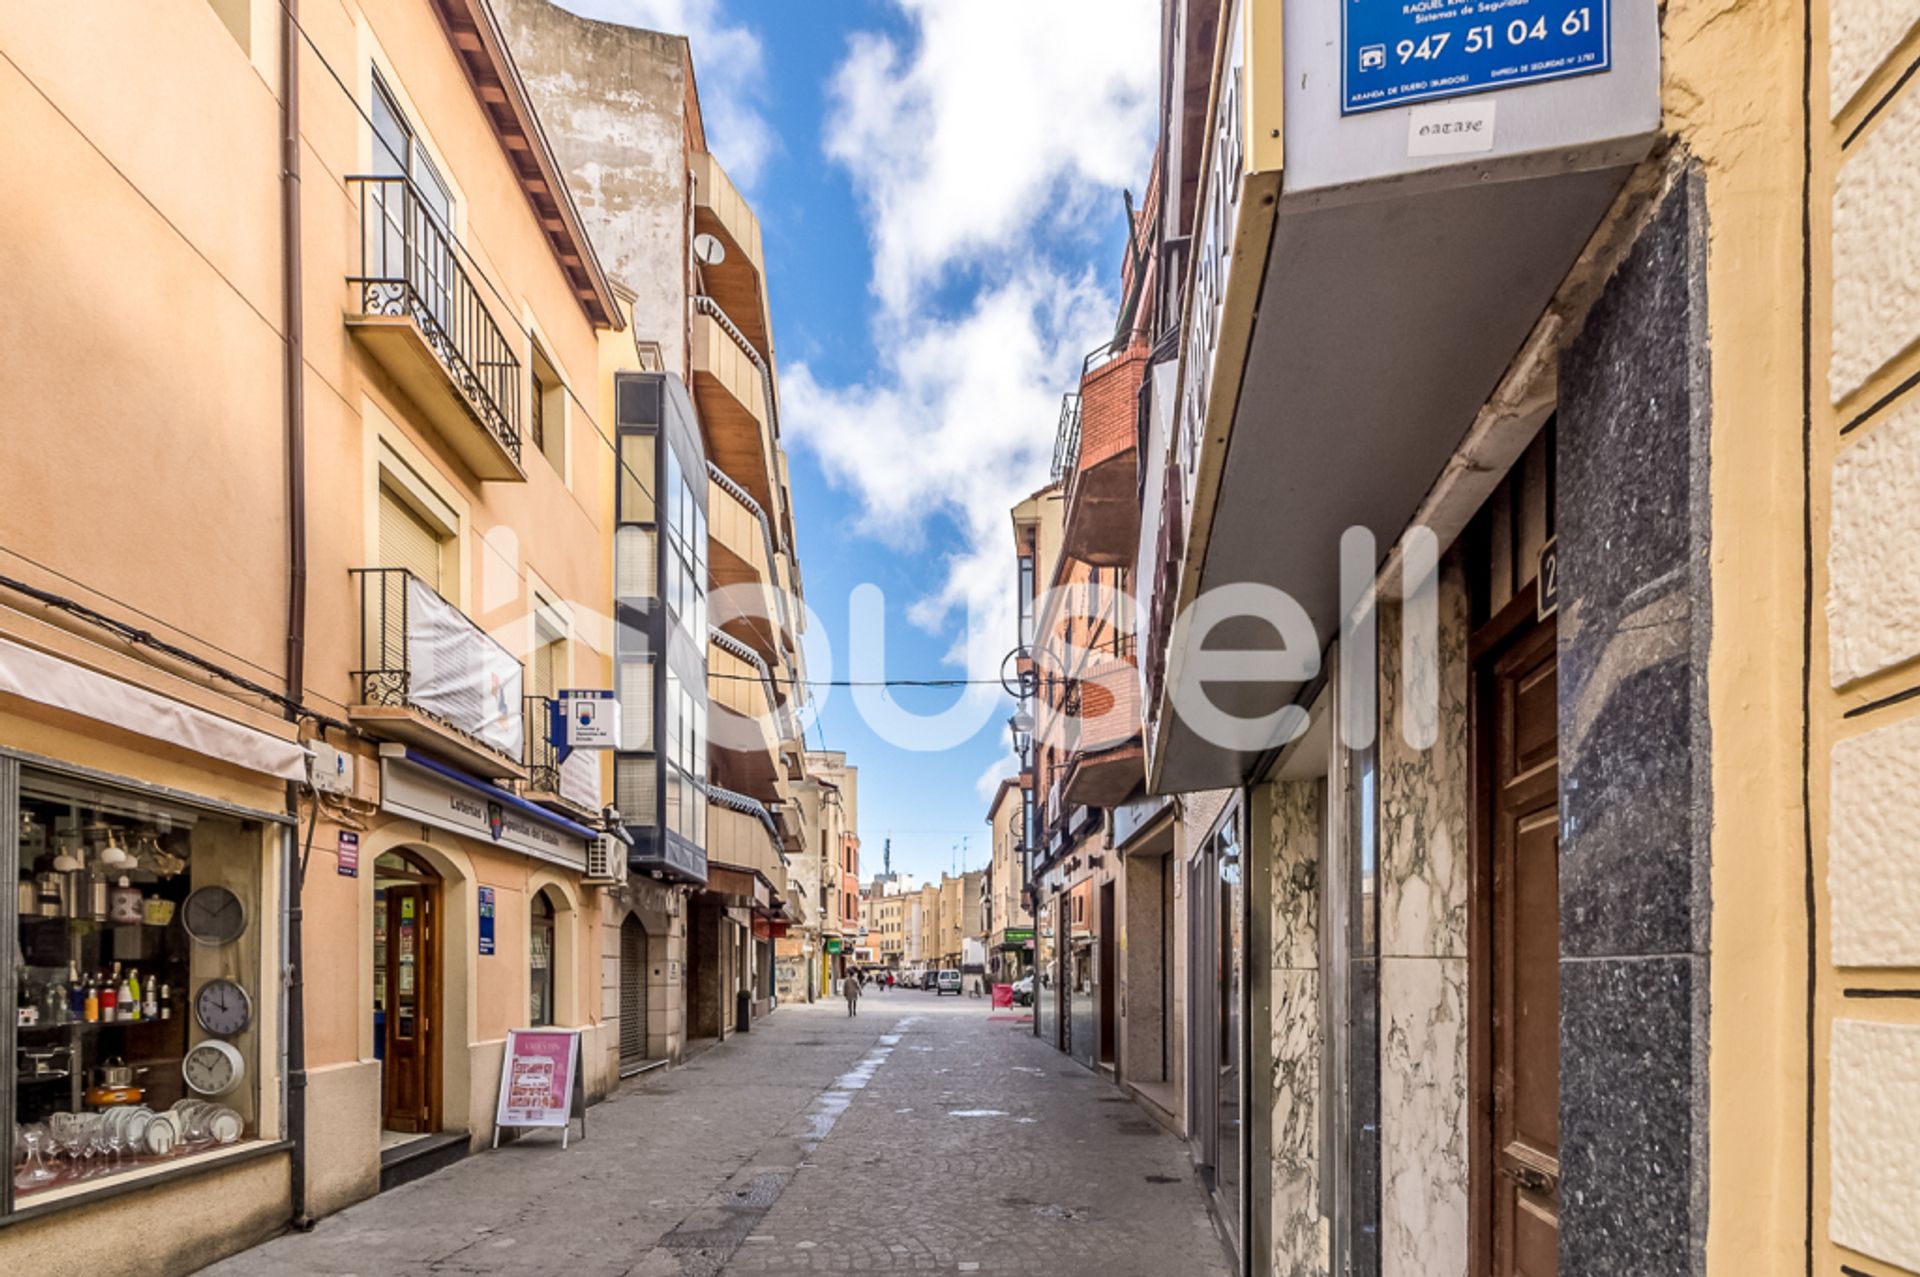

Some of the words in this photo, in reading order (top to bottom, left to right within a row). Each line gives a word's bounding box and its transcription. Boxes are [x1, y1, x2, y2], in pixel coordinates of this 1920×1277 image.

[1415, 10, 1457, 24] Sistemas
[1461, 4, 1473, 15] de
[1396, 32, 1450, 66] 947
[1464, 25, 1494, 53] 51
[1507, 15, 1548, 46] 04
[1561, 8, 1591, 36] 61
[1351, 90, 1385, 102] ARANDA
[1387, 86, 1398, 96] DE
